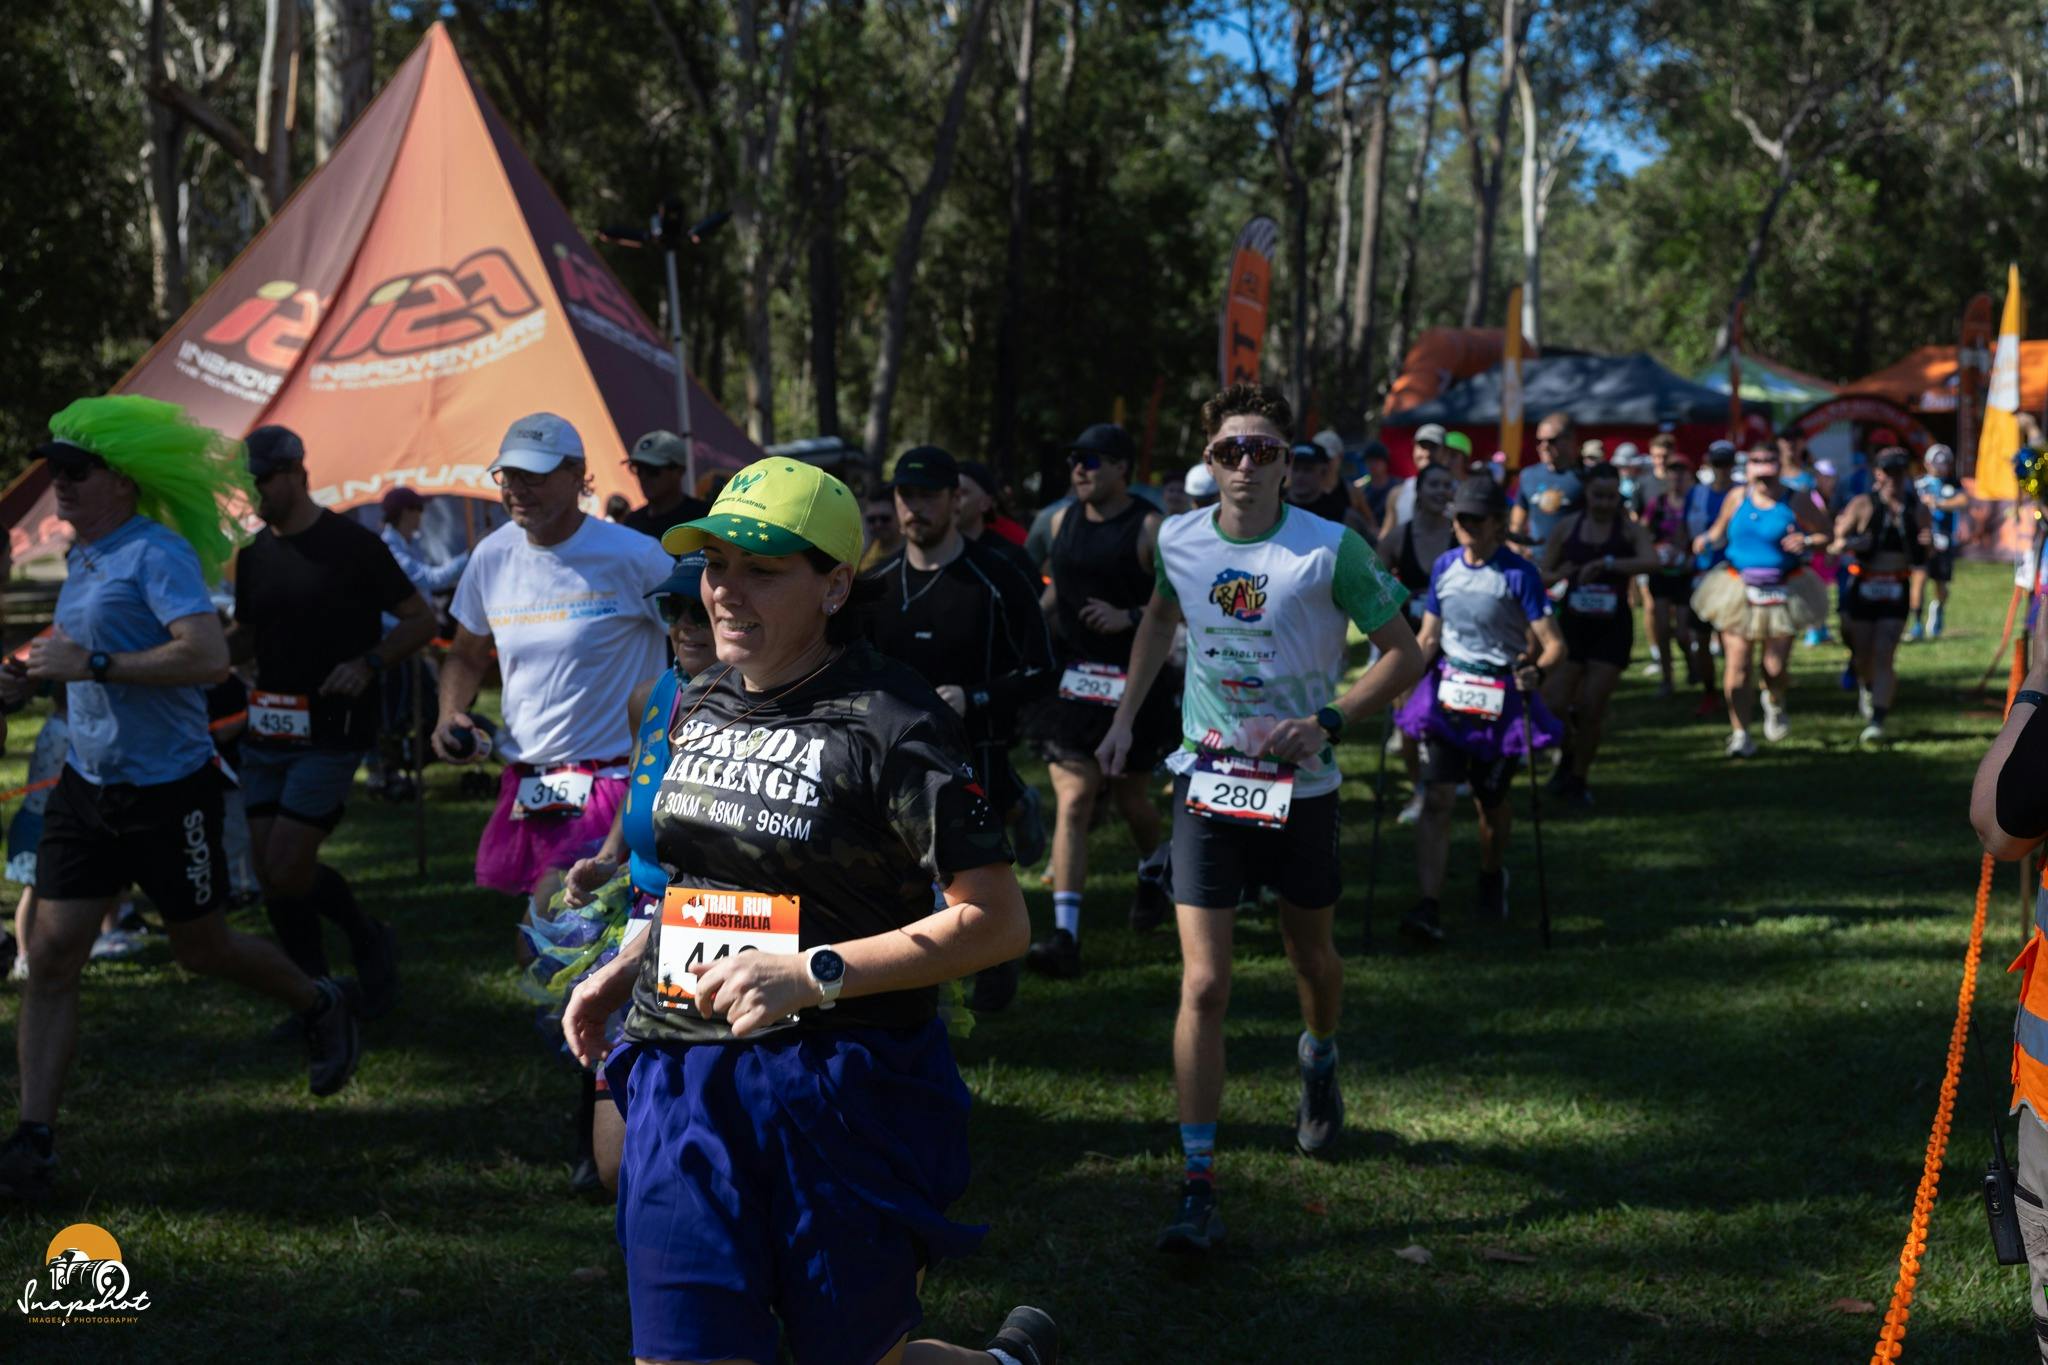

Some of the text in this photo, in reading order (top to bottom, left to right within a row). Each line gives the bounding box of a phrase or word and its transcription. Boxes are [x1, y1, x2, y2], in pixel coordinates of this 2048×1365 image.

[736, 497, 768, 511] Australia
[1209, 573, 1269, 605] GRAND
[1076, 677, 1112, 696] 293
[1452, 689, 1488, 708] 323
[260, 711, 294, 734] 435
[532, 780, 570, 804] 315
[1211, 782, 1268, 811] 280
[665, 791, 702, 818] 30KM
[708, 799, 746, 827] 48KM
[756, 809, 812, 842] 96KM
[183, 808, 212, 906] adidas
[703, 893, 773, 918] TRAIL RUN
[704, 911, 771, 931] AUSTRALIA
